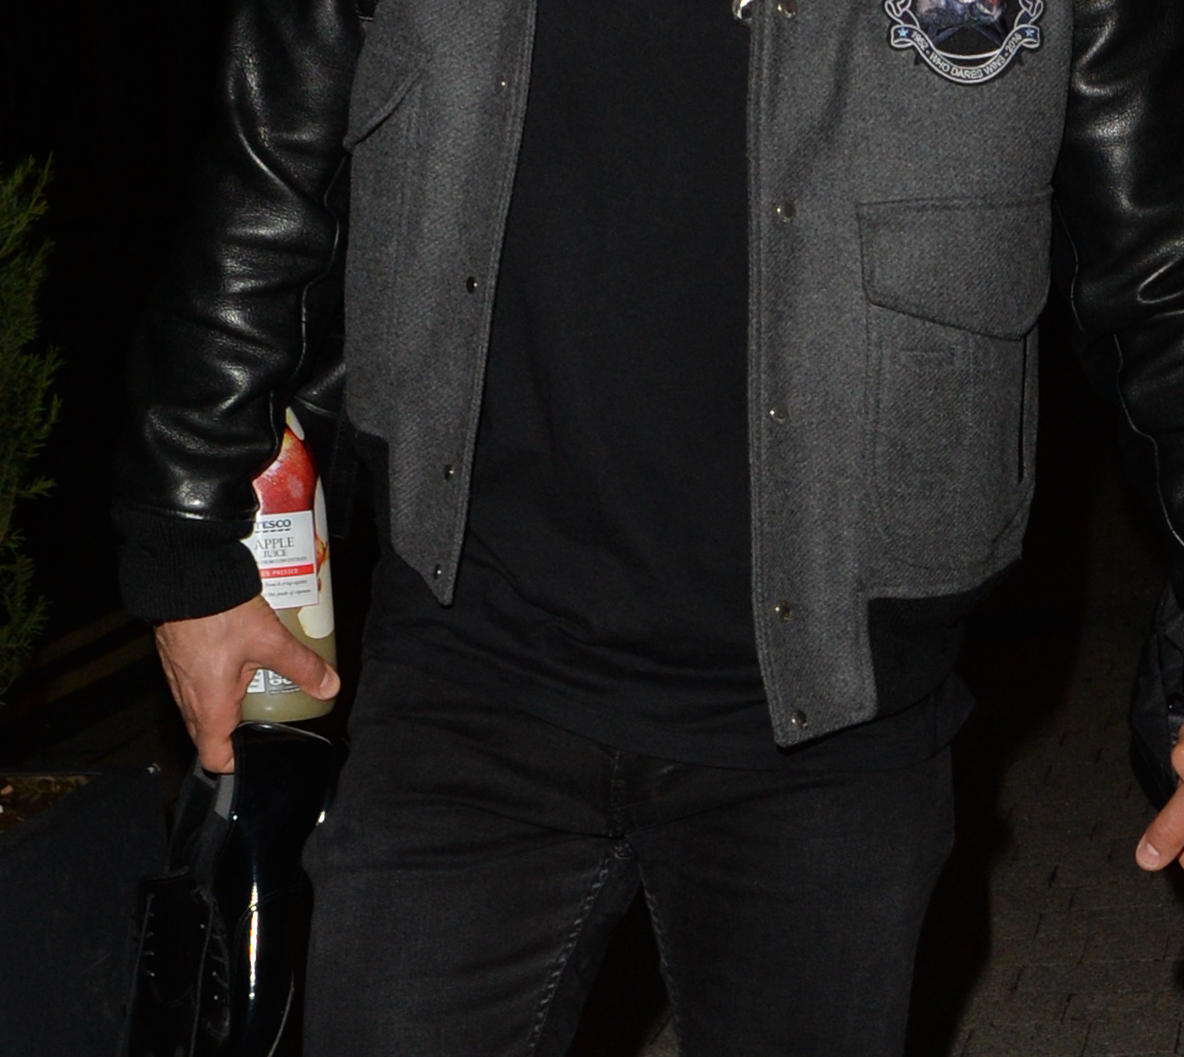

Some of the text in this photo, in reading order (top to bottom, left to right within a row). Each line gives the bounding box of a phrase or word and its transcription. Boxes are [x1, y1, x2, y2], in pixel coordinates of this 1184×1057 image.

[929, 51, 951, 72] WHO
[950, 67, 984, 79] DARES
[983, 55, 1006, 75] WINS
[254, 519, 292, 530] TESCO
[255, 536, 295, 551] APPLE
[263, 549, 287, 558] JUICE
